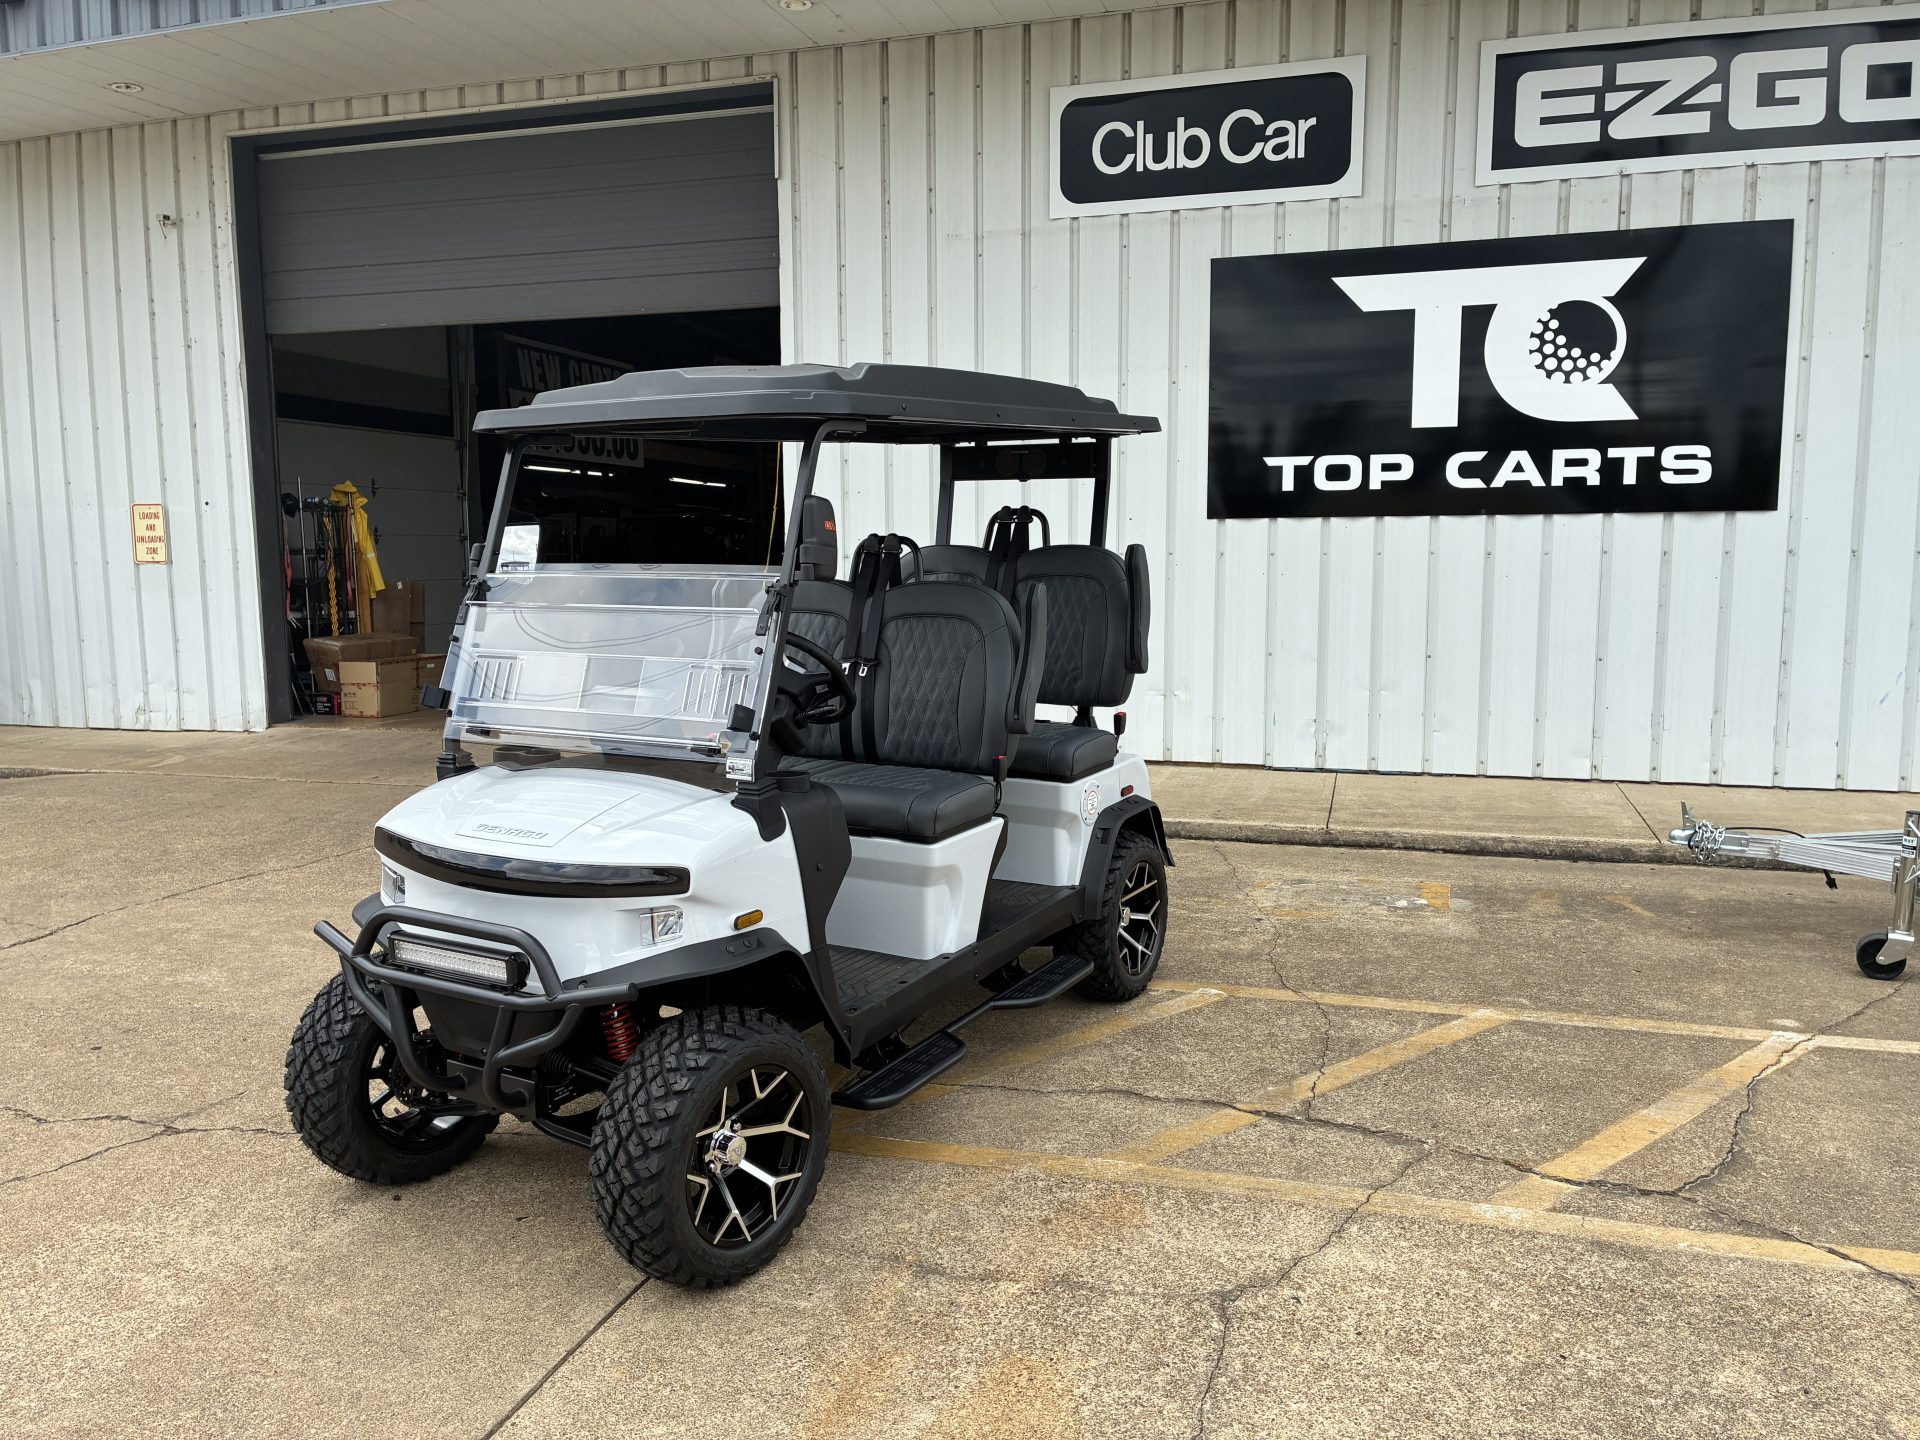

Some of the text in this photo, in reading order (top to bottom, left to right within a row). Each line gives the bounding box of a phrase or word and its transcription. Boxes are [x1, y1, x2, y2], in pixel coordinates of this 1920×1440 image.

[1514, 40, 1920, 148] EZGO
[1091, 108, 1317, 175] Club Car
[516, 347, 561, 391] NEW
[1262, 444, 1713, 492] TOP CARTS
[138, 511, 160, 520] LOADING
[145, 523, 156, 531] AND
[136, 535, 165, 544] UNLOADING
[145, 546, 159, 556] ZONE
